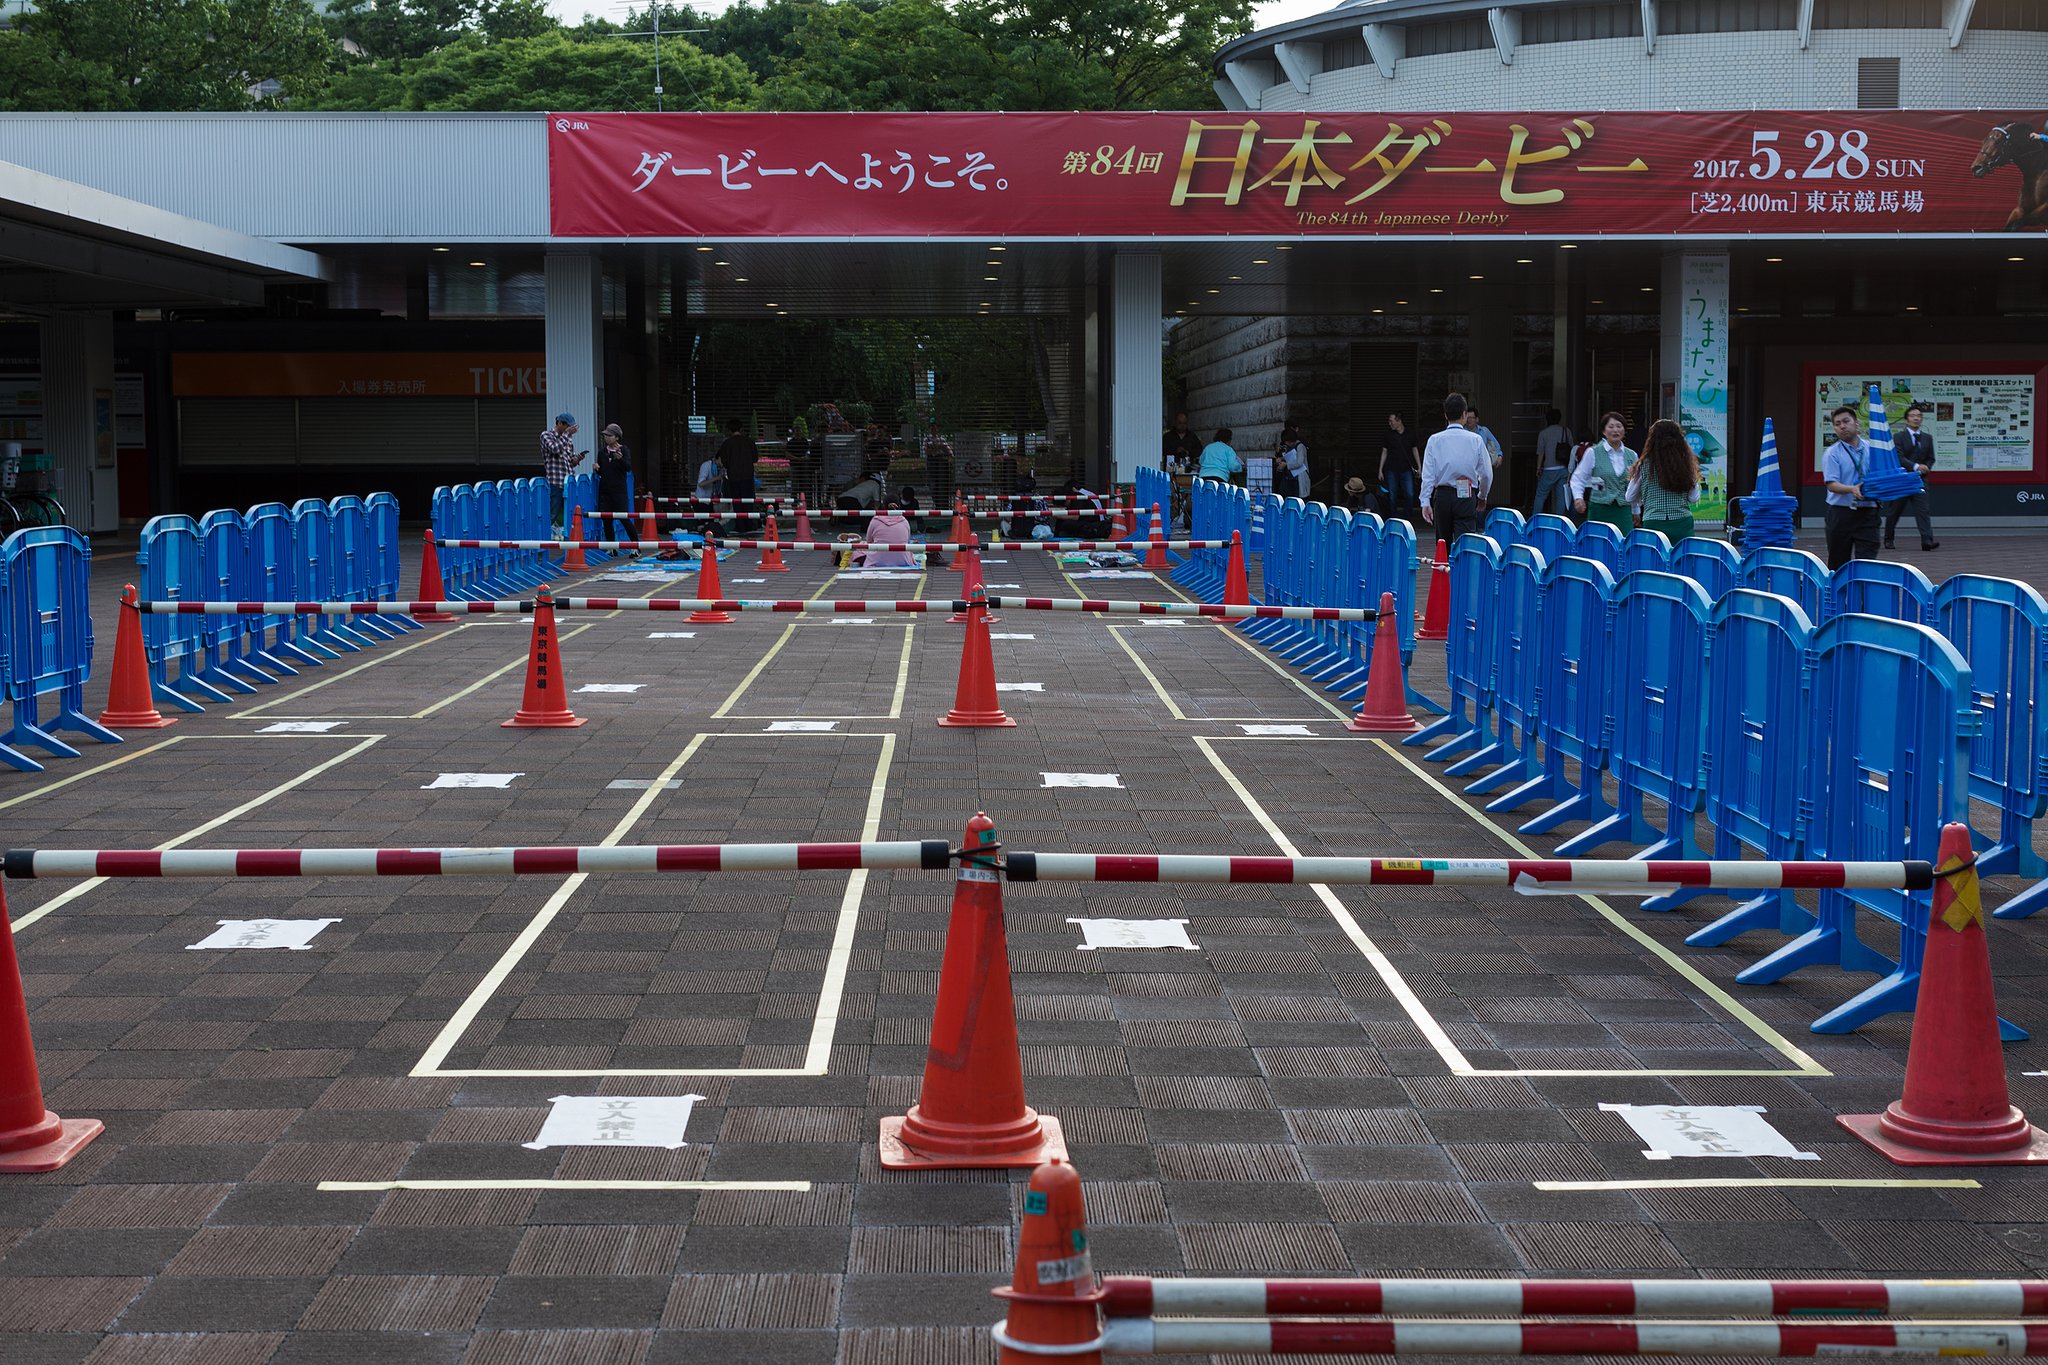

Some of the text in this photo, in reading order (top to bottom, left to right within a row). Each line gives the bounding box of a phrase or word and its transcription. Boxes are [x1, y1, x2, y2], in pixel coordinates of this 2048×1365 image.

[571, 121, 590, 131] JRA
[631, 149, 1008, 193] ダービーへようこそ。
[1060, 118, 1649, 207] 第84回 日本ダービー
[1874, 159, 1926, 178] SUN
[1296, 211, 1327, 225] The
[1374, 211, 1450, 228] Japanese
[1456, 211, 1509, 227] Derby
[1804, 190, 1925, 214] 東京競馬場
[1688, 288, 1724, 405] うまたび
[336, 379, 427, 395] 入場券発売所
[536, 625, 548, 690] 東京競馬場
[592, 1100, 639, 1141] 立入禁止
[1655, 1109, 1743, 1153] 立入禁止
